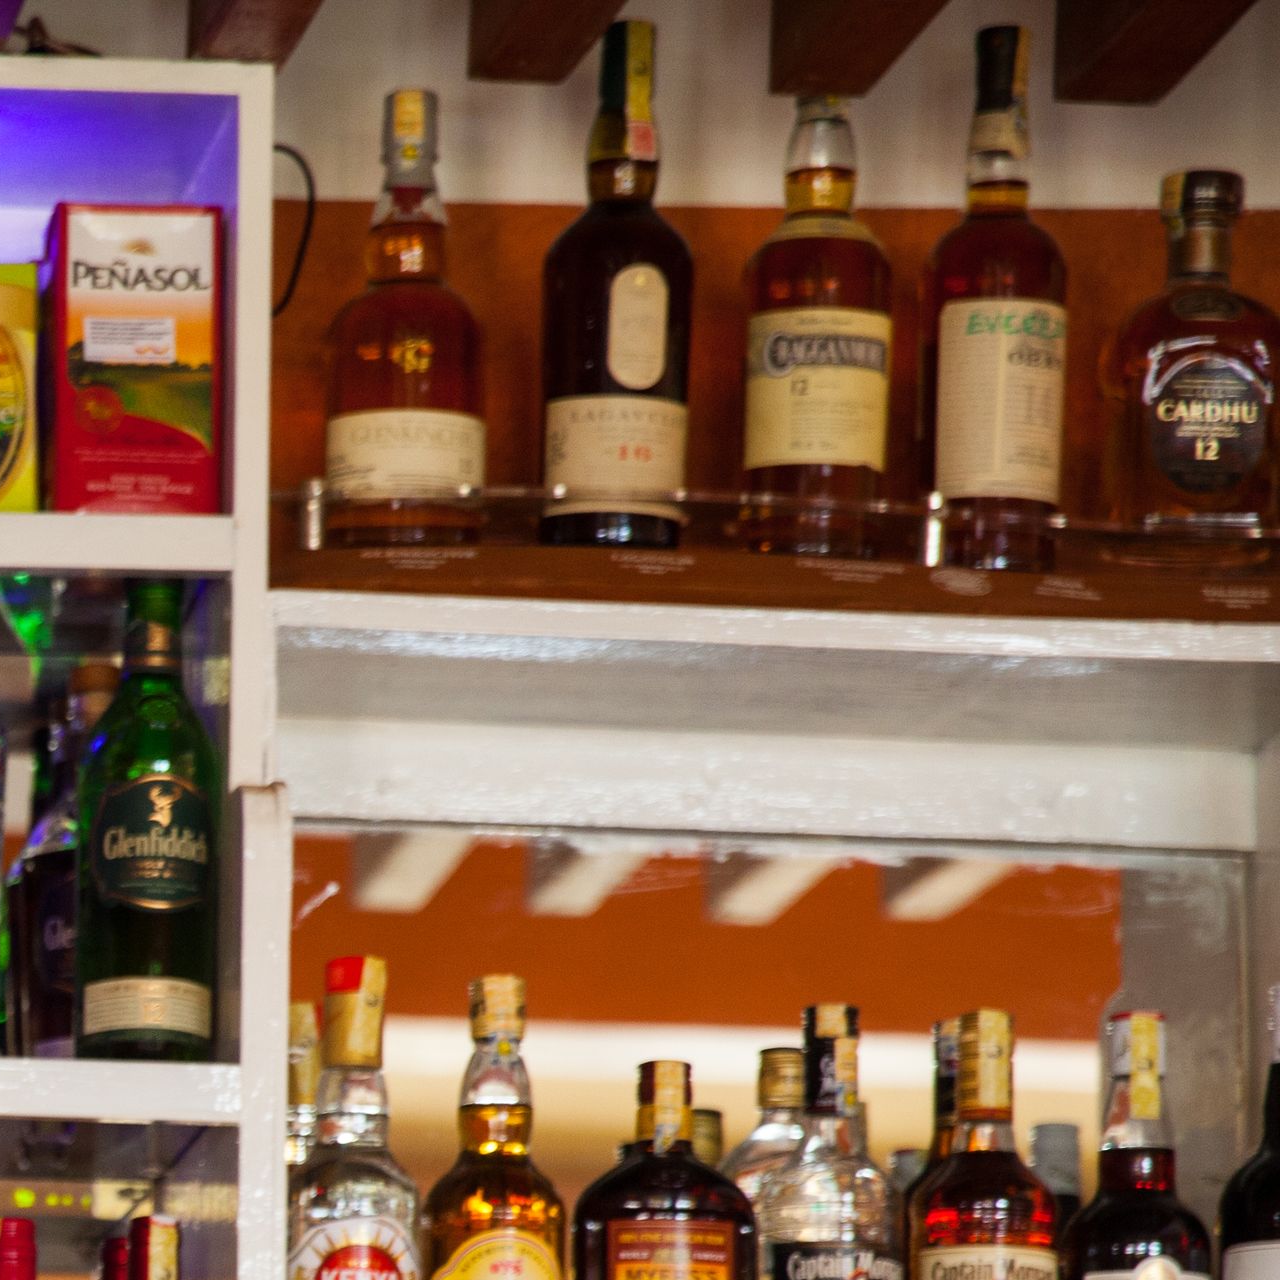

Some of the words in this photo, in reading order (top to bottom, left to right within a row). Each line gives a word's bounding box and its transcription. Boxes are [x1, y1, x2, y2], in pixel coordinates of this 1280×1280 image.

[72, 258, 212, 292] PEÑASOL
[1156, 400, 1260, 424] CARDHU
[1194, 439, 1220, 461] 12
